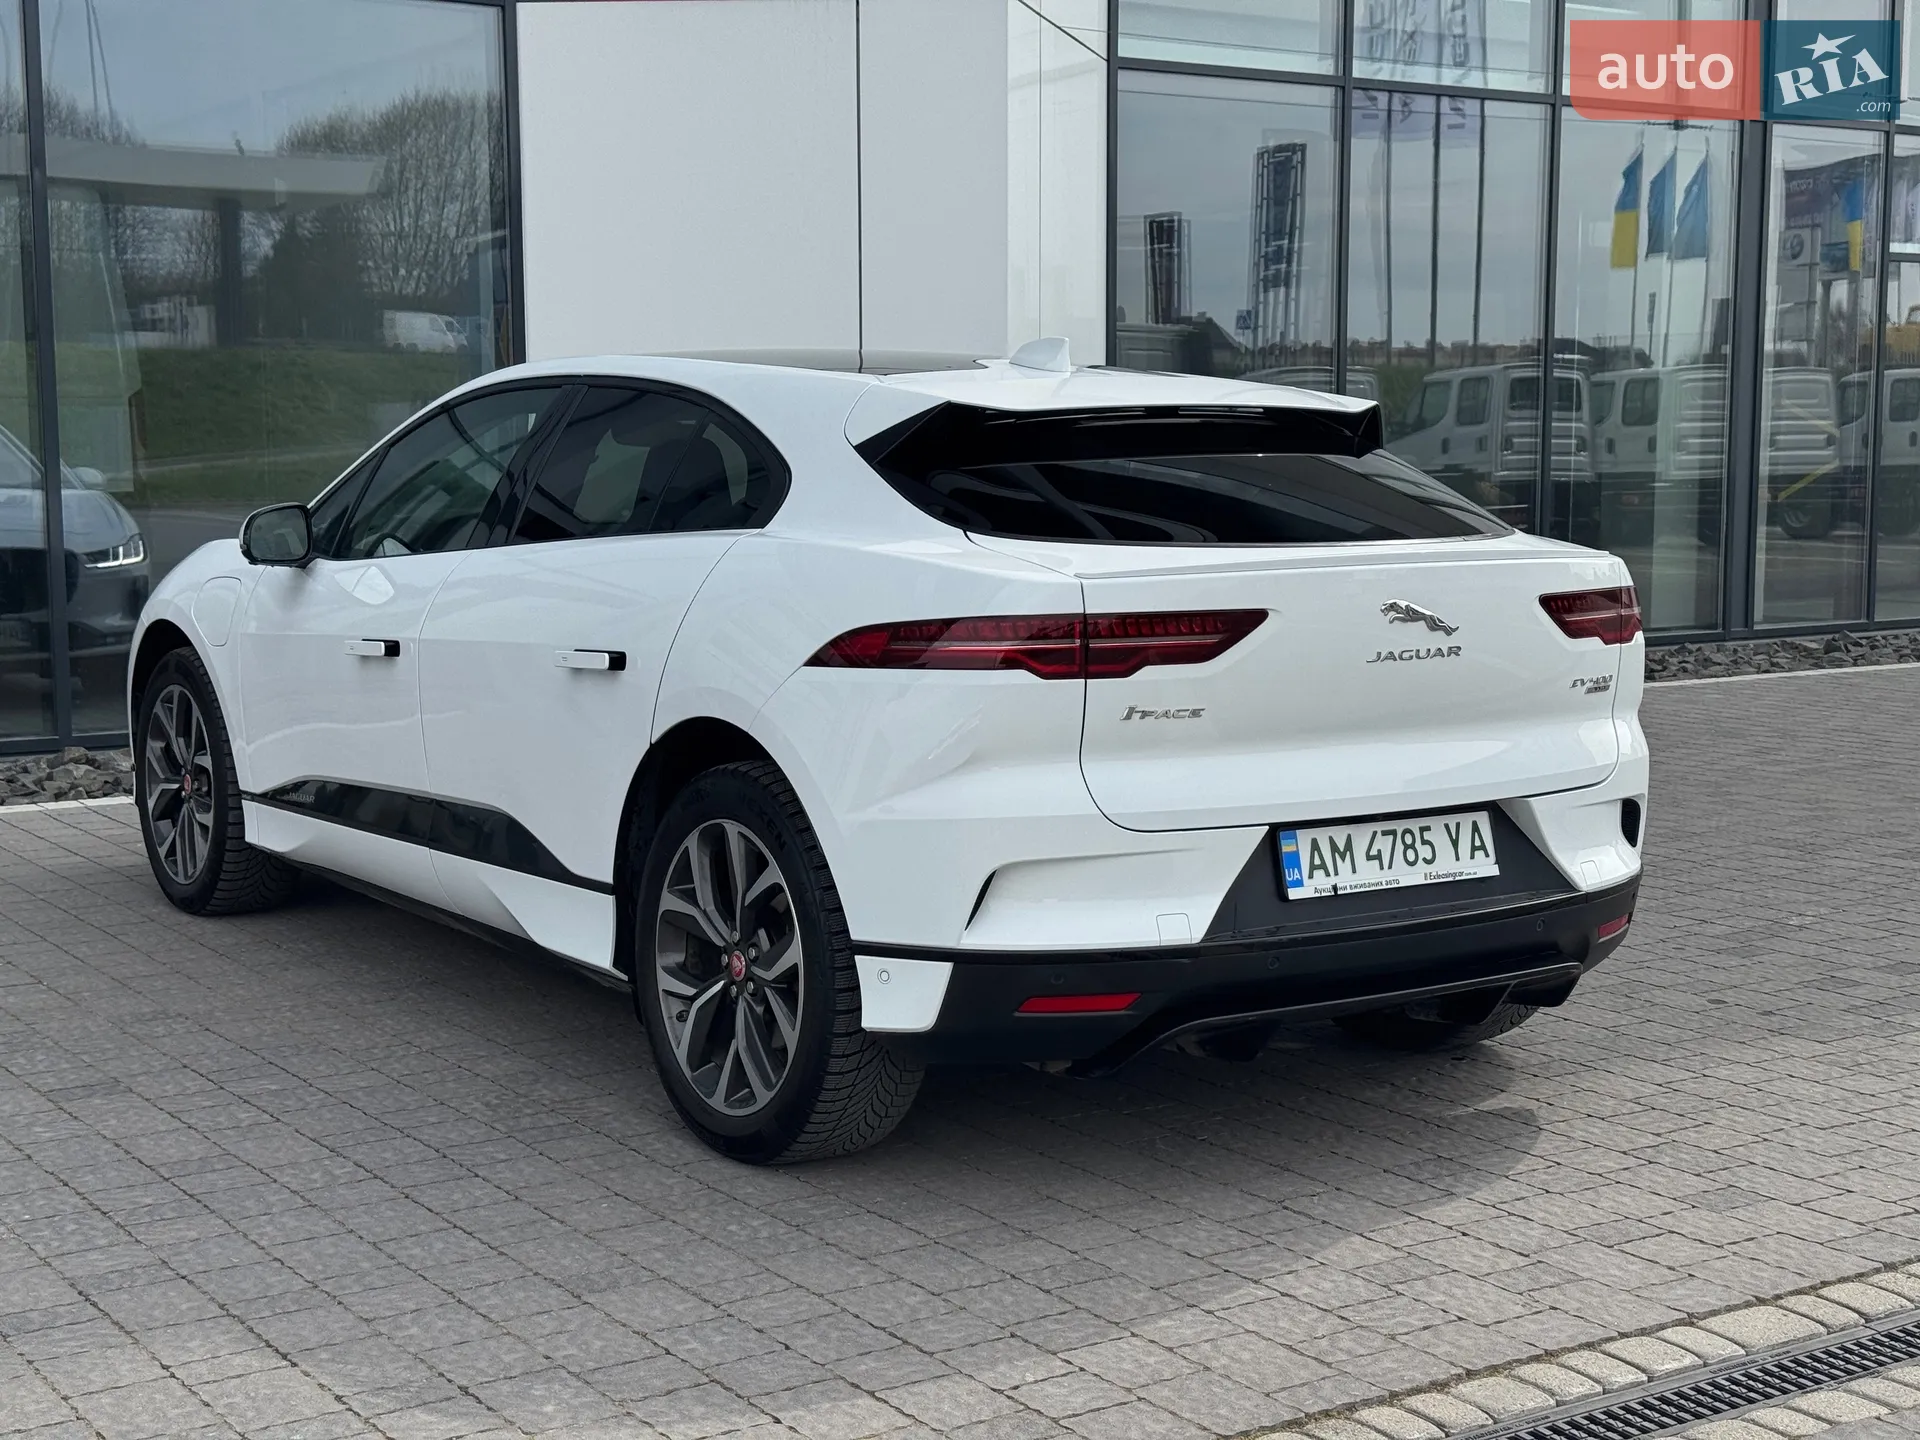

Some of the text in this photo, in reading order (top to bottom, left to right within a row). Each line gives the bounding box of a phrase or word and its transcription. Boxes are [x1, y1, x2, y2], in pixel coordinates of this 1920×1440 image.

[1366, 645, 1462, 663] JAGUAR
[1307, 820, 1490, 880] AM 4785 YA
[1285, 867, 1302, 881] UA
